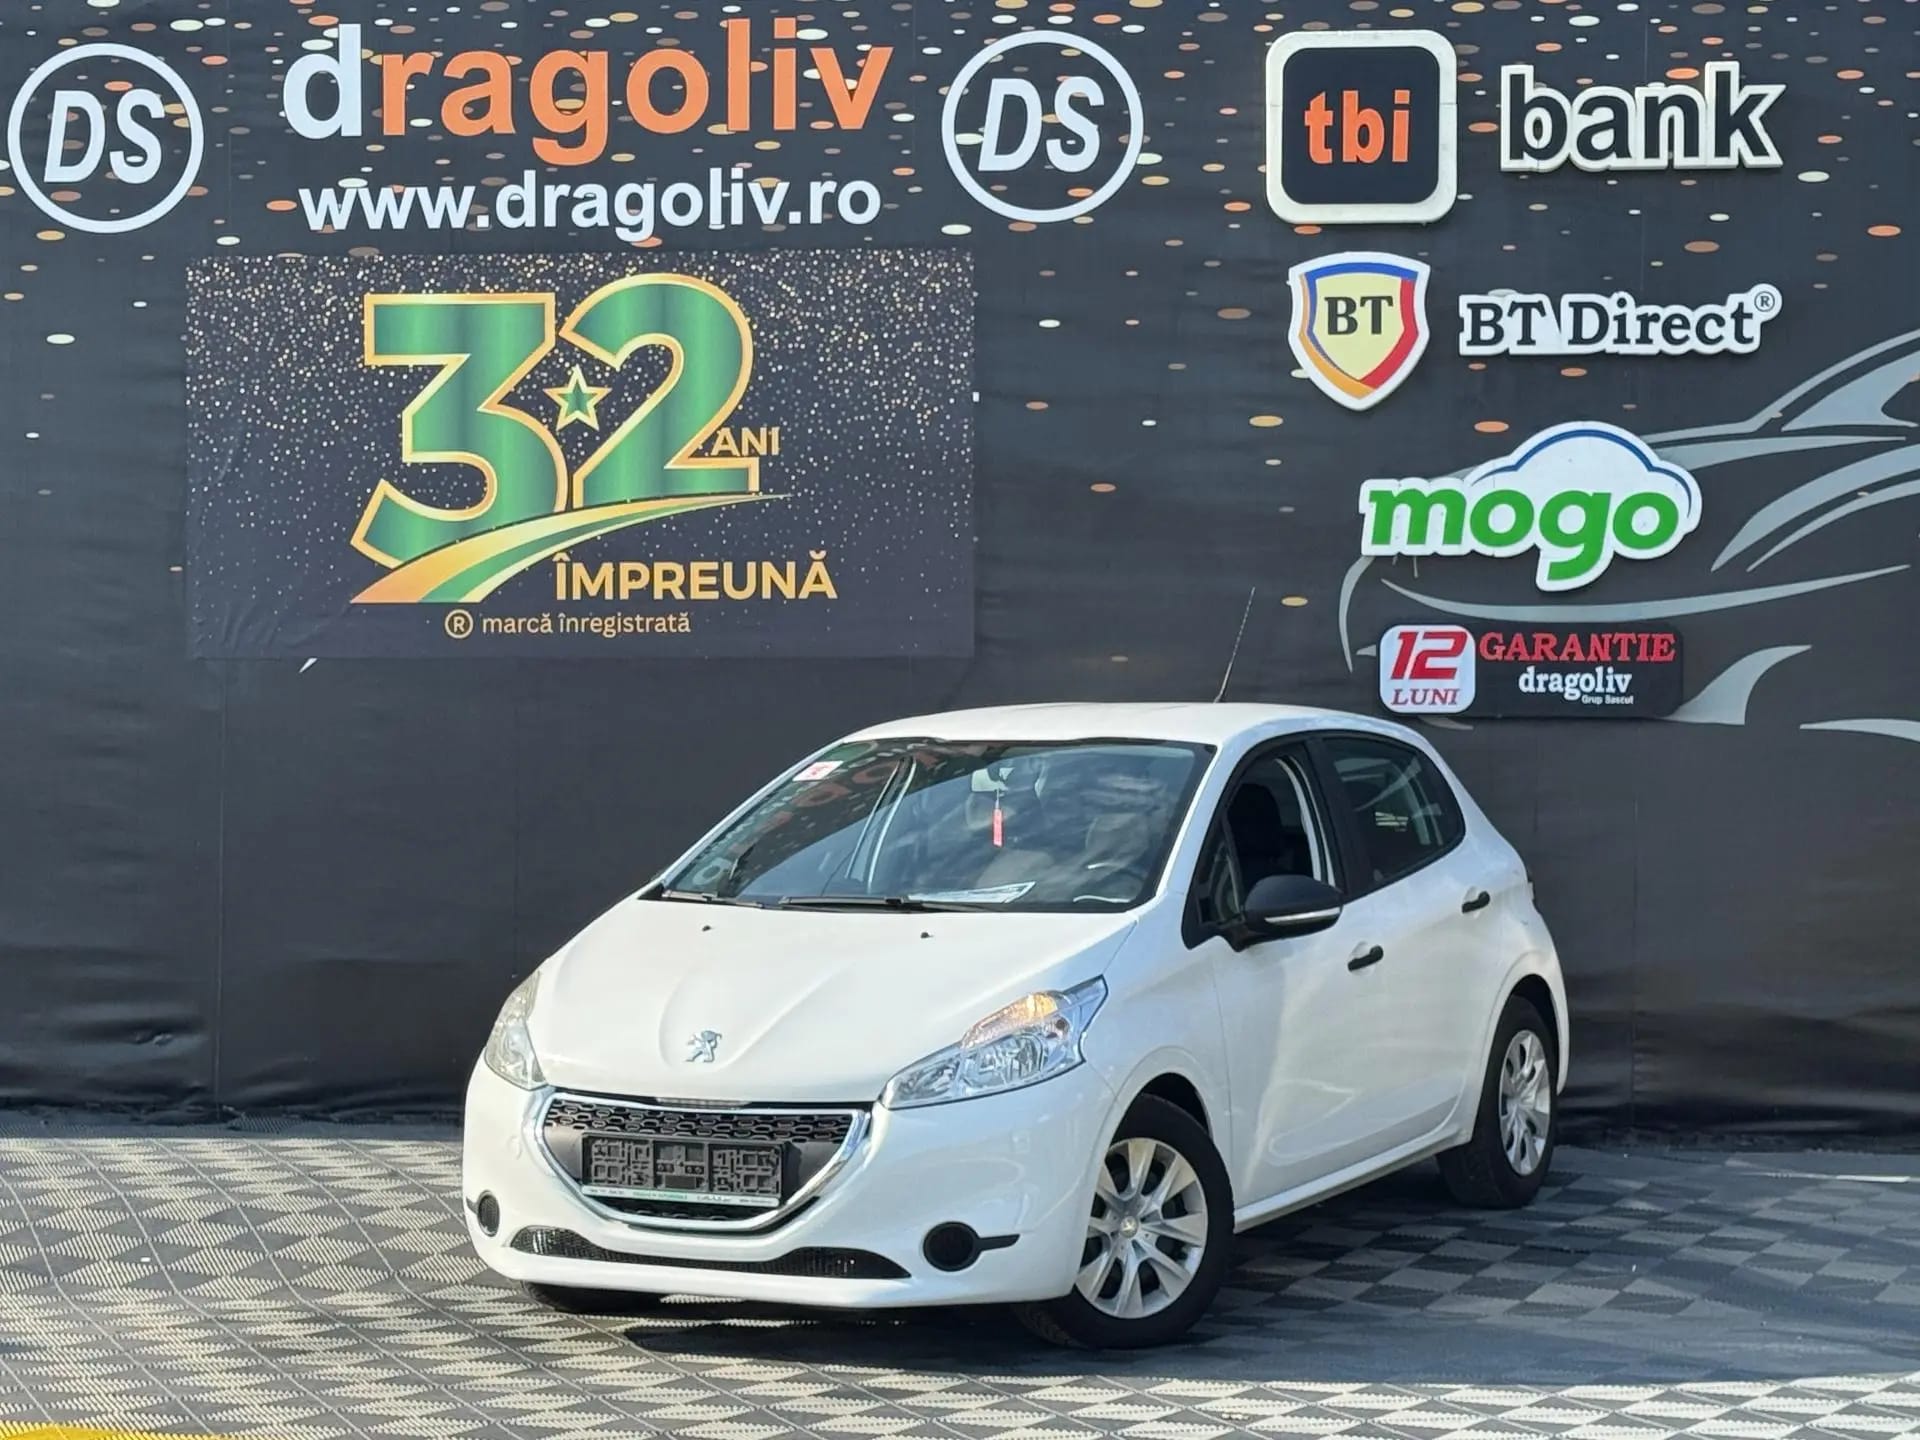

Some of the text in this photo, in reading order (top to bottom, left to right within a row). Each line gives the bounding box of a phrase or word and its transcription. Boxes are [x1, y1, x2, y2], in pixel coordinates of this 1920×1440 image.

[283, 18, 893, 165] dragoliv
[43, 88, 165, 185] DS
[978, 76, 1105, 172] DS
[1304, 70, 1778, 164] tbi bank
[298, 168, 881, 242] www.dragoliv.ro
[1324, 295, 1394, 336] BT
[1466, 301, 1547, 346] BT
[350, 272, 759, 569] 32
[711, 426, 781, 457] ANI
[1368, 489, 1680, 581] mogo
[552, 549, 838, 601] ÎMPREUNĂ
[482, 613, 553, 635] marcă
[558, 612, 692, 639] înregistrată
[1479, 632, 1676, 663] GARANTIE
[1390, 631, 1467, 680] 12
[1391, 688, 1460, 706] LUNI
[1518, 665, 1633, 701] dragoliv
